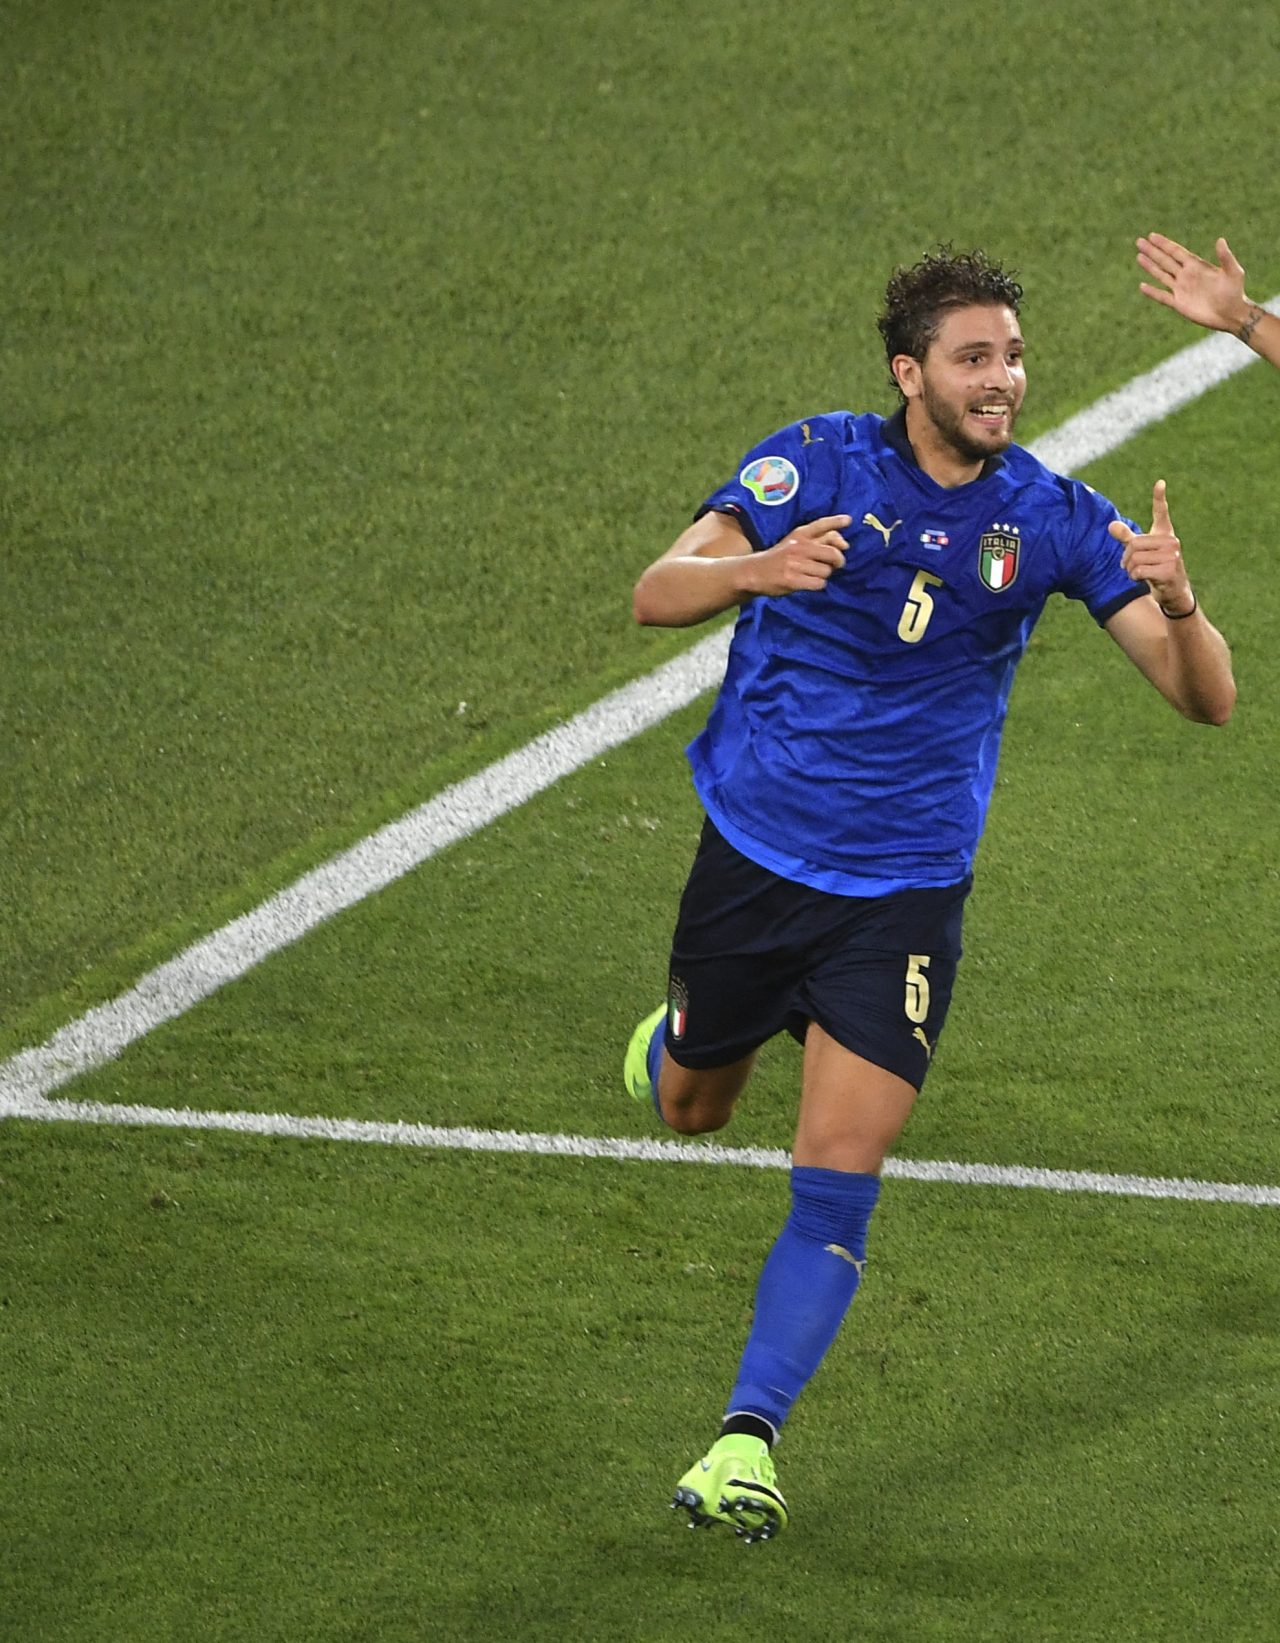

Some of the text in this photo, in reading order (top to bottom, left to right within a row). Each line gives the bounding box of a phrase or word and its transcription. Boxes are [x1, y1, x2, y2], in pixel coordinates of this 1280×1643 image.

[983, 537, 1016, 550] ITALIA
[897, 569, 944, 644] 5
[904, 954, 931, 1023] 5
